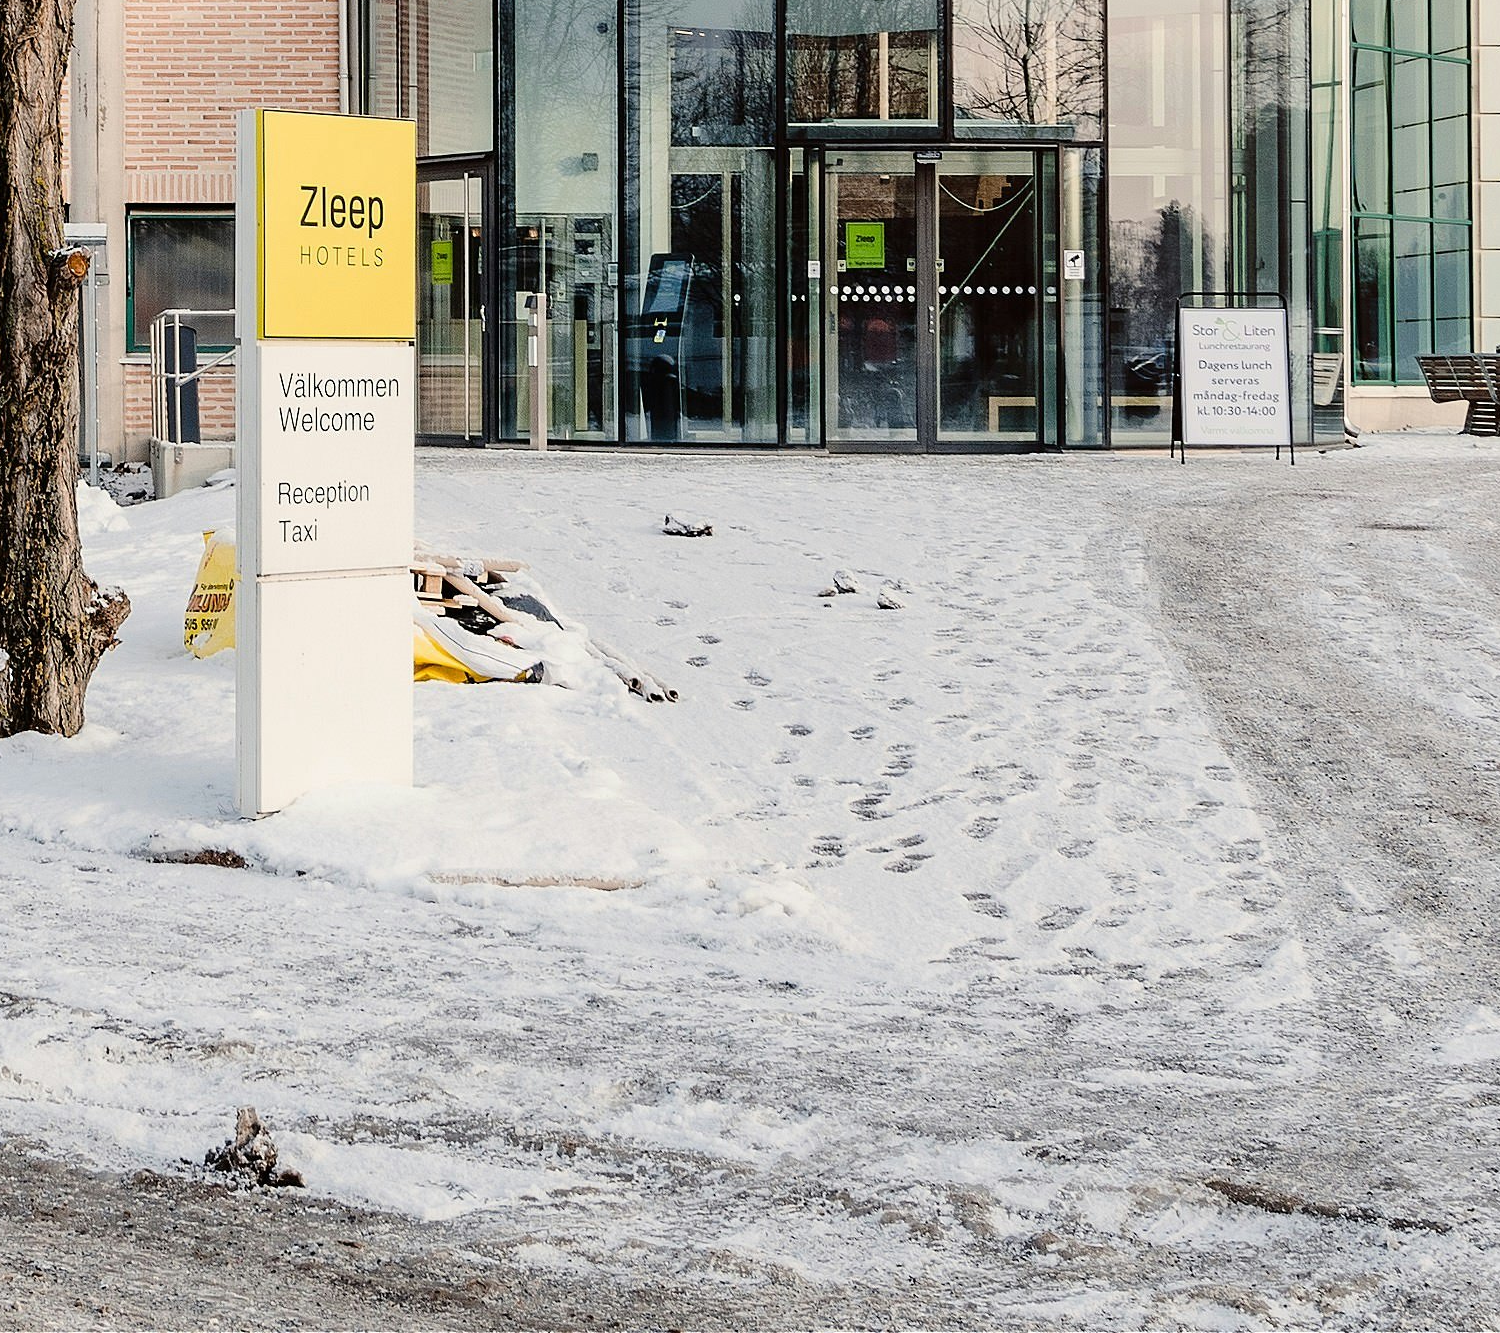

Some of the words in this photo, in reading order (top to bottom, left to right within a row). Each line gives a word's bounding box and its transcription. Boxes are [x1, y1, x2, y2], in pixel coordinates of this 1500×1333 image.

[299, 185, 385, 239] Zleep
[299, 244, 384, 268] HOTELS
[1192, 324, 1219, 336] Stor
[1221, 319, 1241, 341] &
[1244, 324, 1276, 336] Liten
[1198, 342, 1271, 352] Lunchrestaurang
[1198, 359, 1239, 372] Dagens
[1241, 360, 1273, 370] lunch
[278, 372, 400, 398] Välkommen
[1211, 377, 1260, 385] serveras
[1193, 390, 1280, 403] måndag-fredag
[278, 406, 376, 432] Welcome
[1212, 406, 1276, 416] 10:30-14:00
[278, 480, 370, 509] Reception
[278, 518, 319, 543] Taxi
